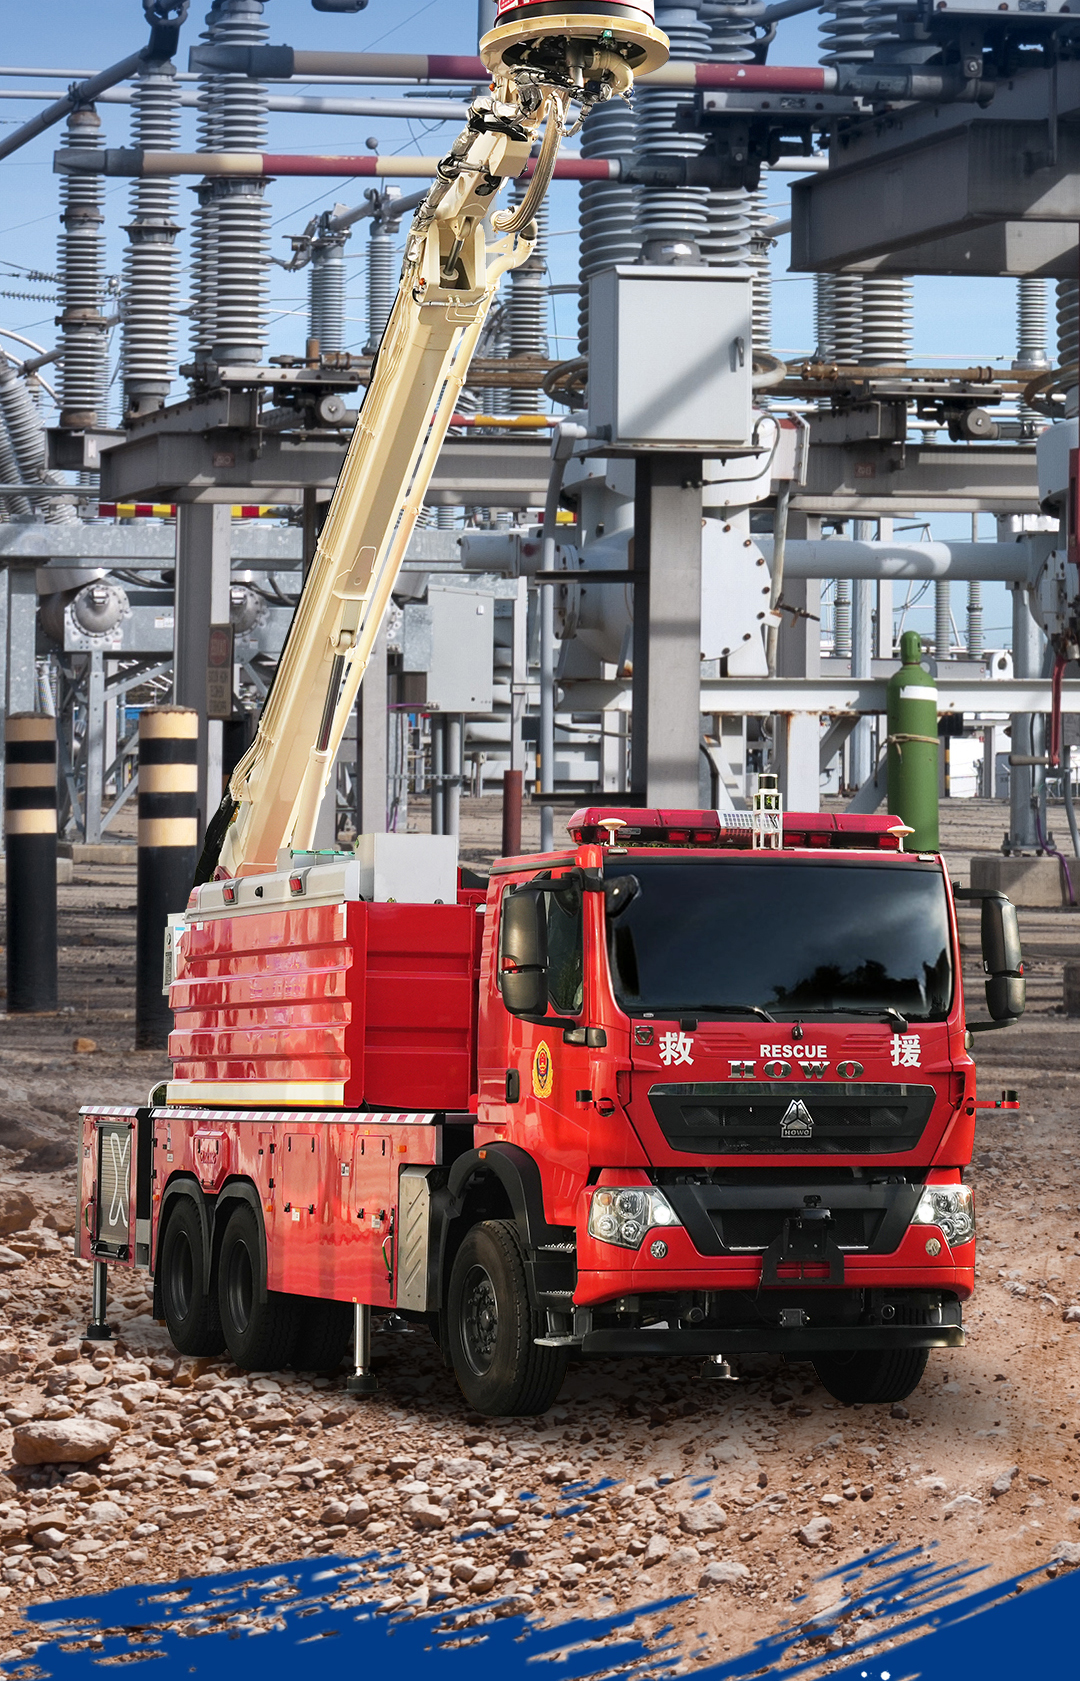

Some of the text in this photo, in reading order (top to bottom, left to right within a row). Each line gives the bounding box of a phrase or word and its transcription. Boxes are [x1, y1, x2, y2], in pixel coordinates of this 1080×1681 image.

[659, 1031, 922, 1068] 救 RESCUE 援
[727, 1060, 865, 1079] HOWO
